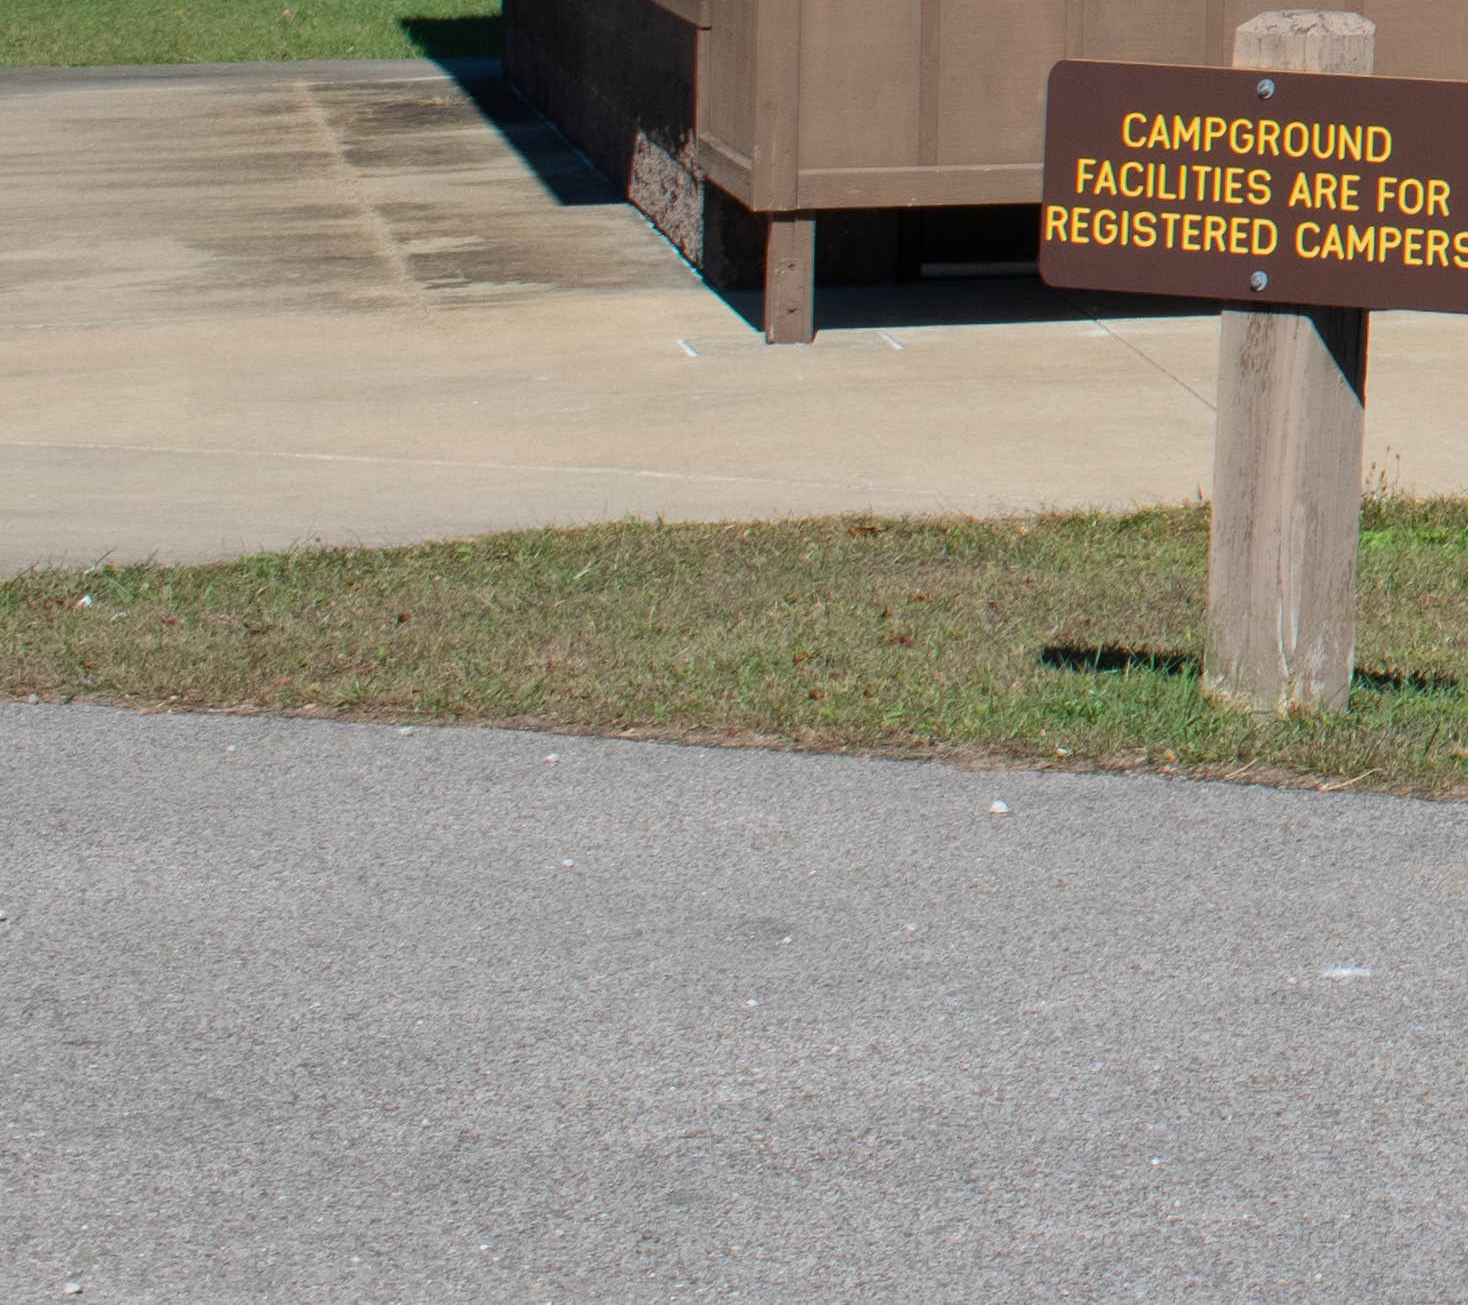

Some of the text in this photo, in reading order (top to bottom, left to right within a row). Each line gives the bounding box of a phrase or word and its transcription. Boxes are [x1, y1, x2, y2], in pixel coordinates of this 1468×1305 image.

[1122, 112, 1392, 163] CAMPGROUND
[1076, 158, 1451, 217] FACILITIES ARE FOR
[1045, 205, 1278, 256] REGISTERED
